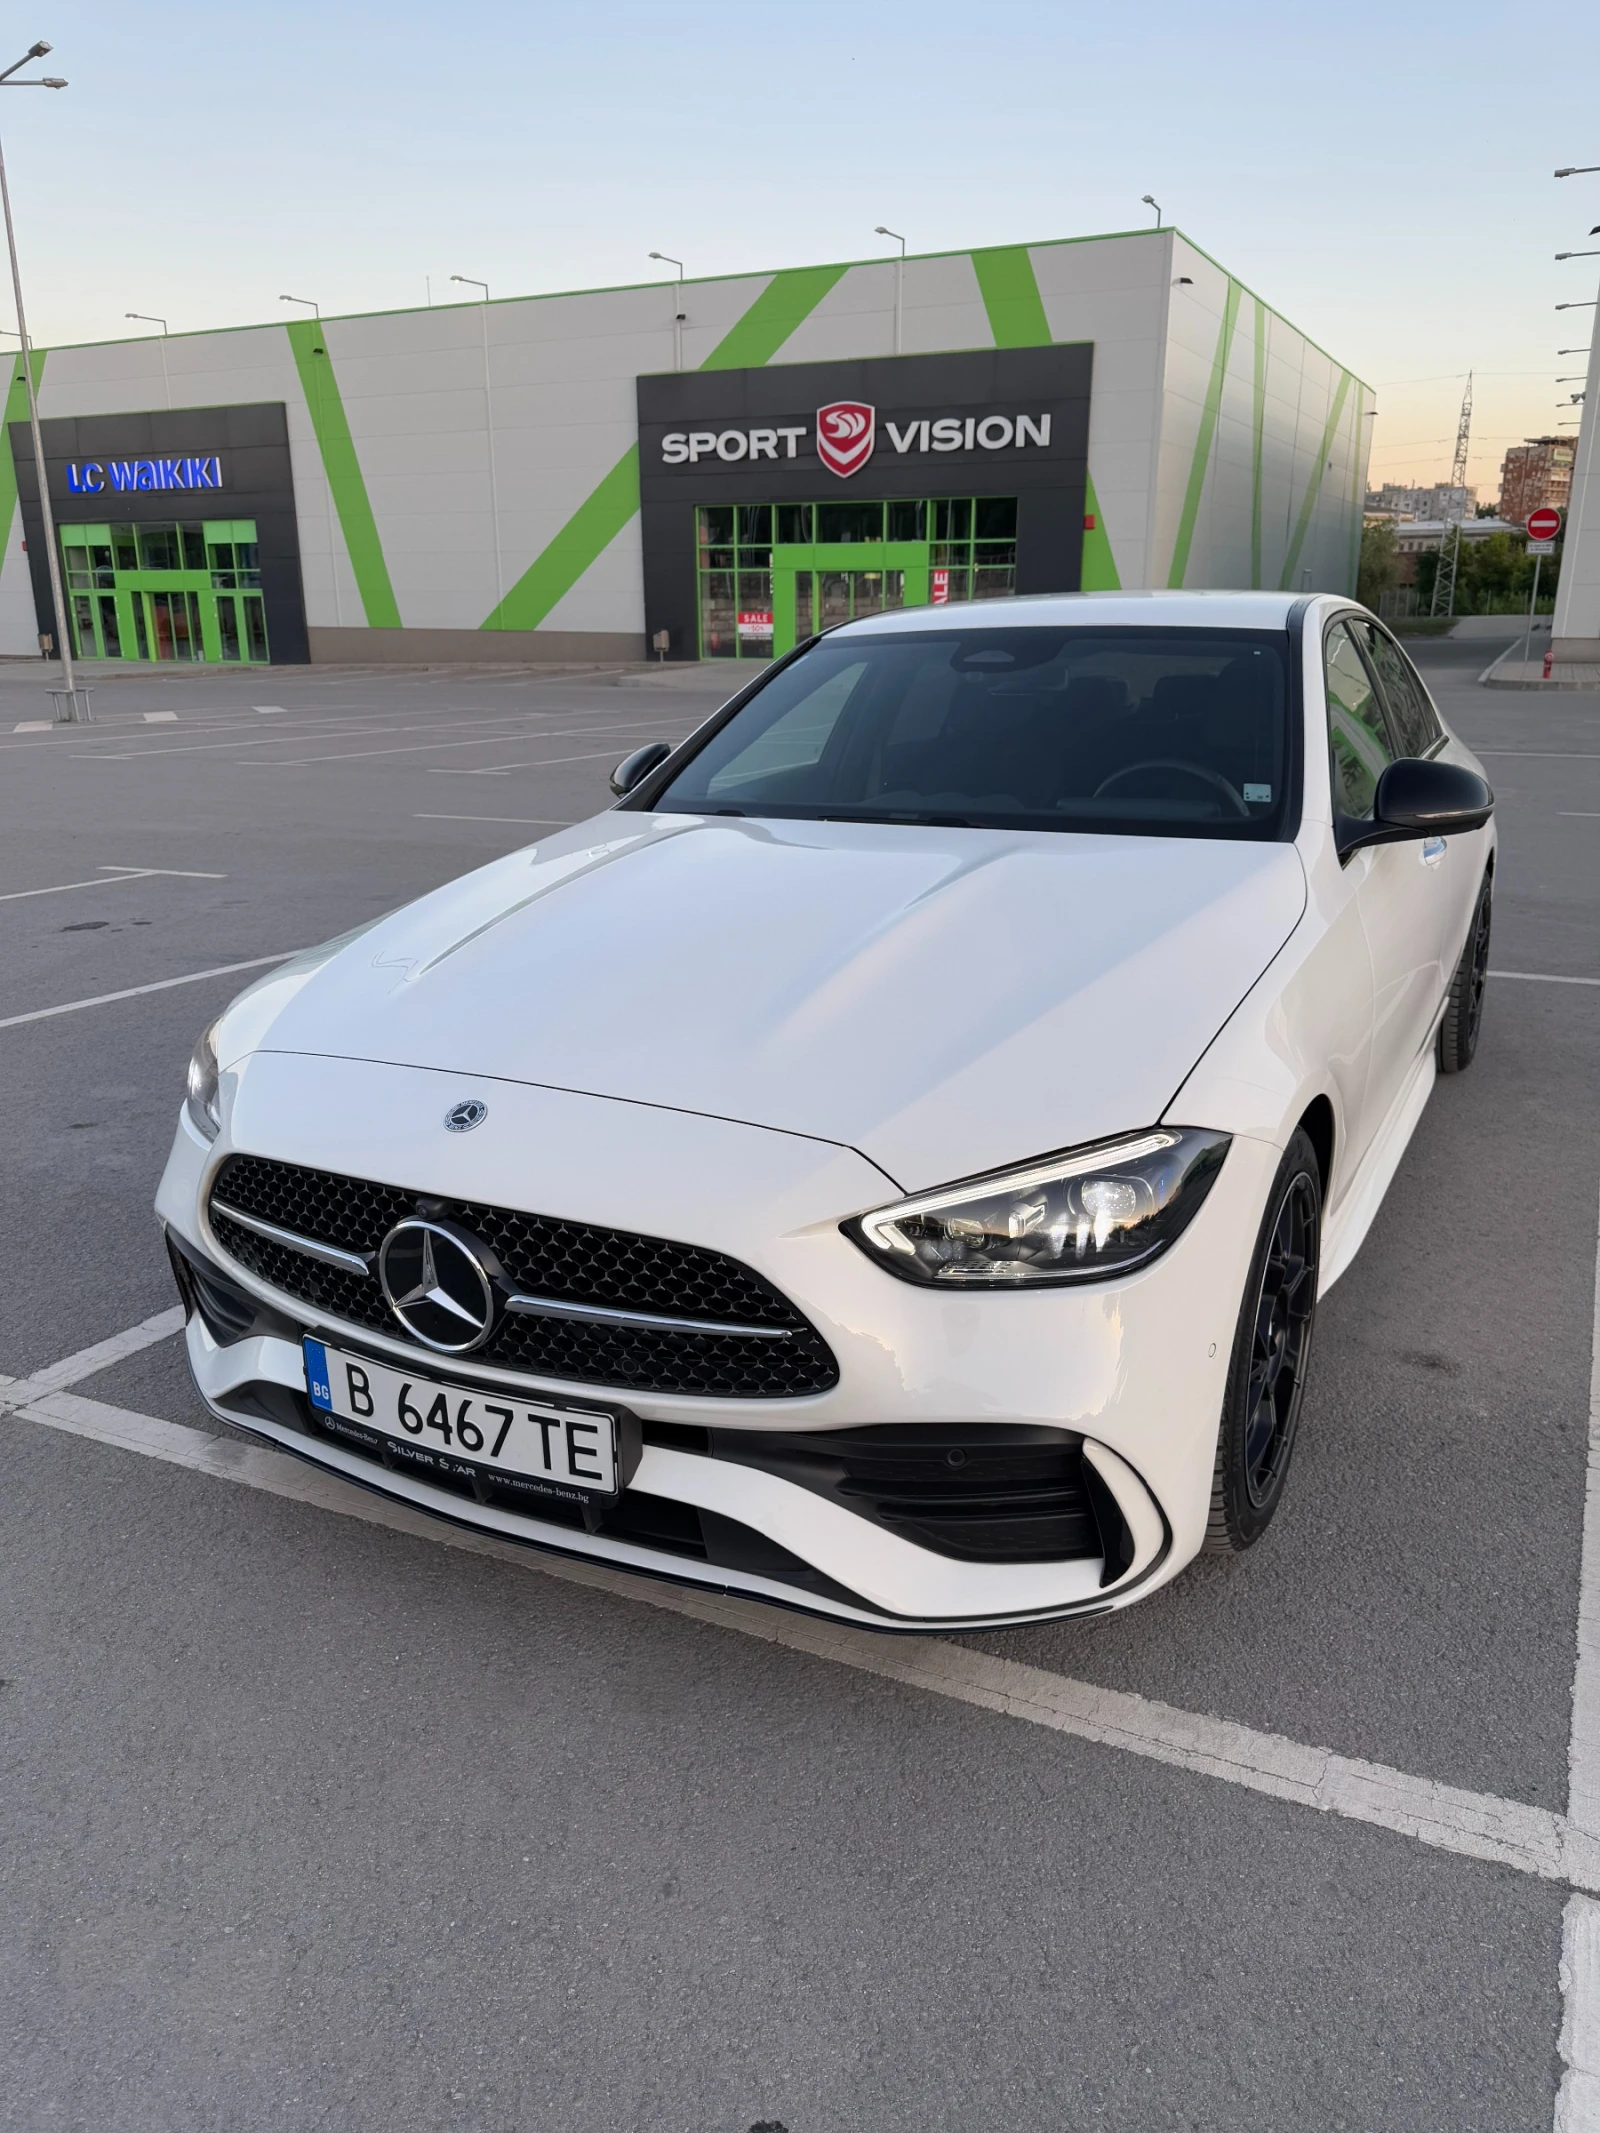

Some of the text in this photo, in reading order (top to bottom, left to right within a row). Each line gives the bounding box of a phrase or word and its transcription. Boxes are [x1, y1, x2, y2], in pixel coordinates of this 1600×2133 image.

[661, 413, 1052, 464] SPORT VISION
[66, 462, 105, 493] LC
[933, 571, 949, 605] ALE
[743, 613, 769, 623] SALE
[312, 1380, 330, 1400] BG
[336, 1422, 379, 1445] Mercedes-Benz
[345, 1361, 604, 1481] B 6467 TE
[387, 1440, 477, 1478] SILVER SAR
[487, 1473, 590, 1504] www.mercedes-benz.bg
